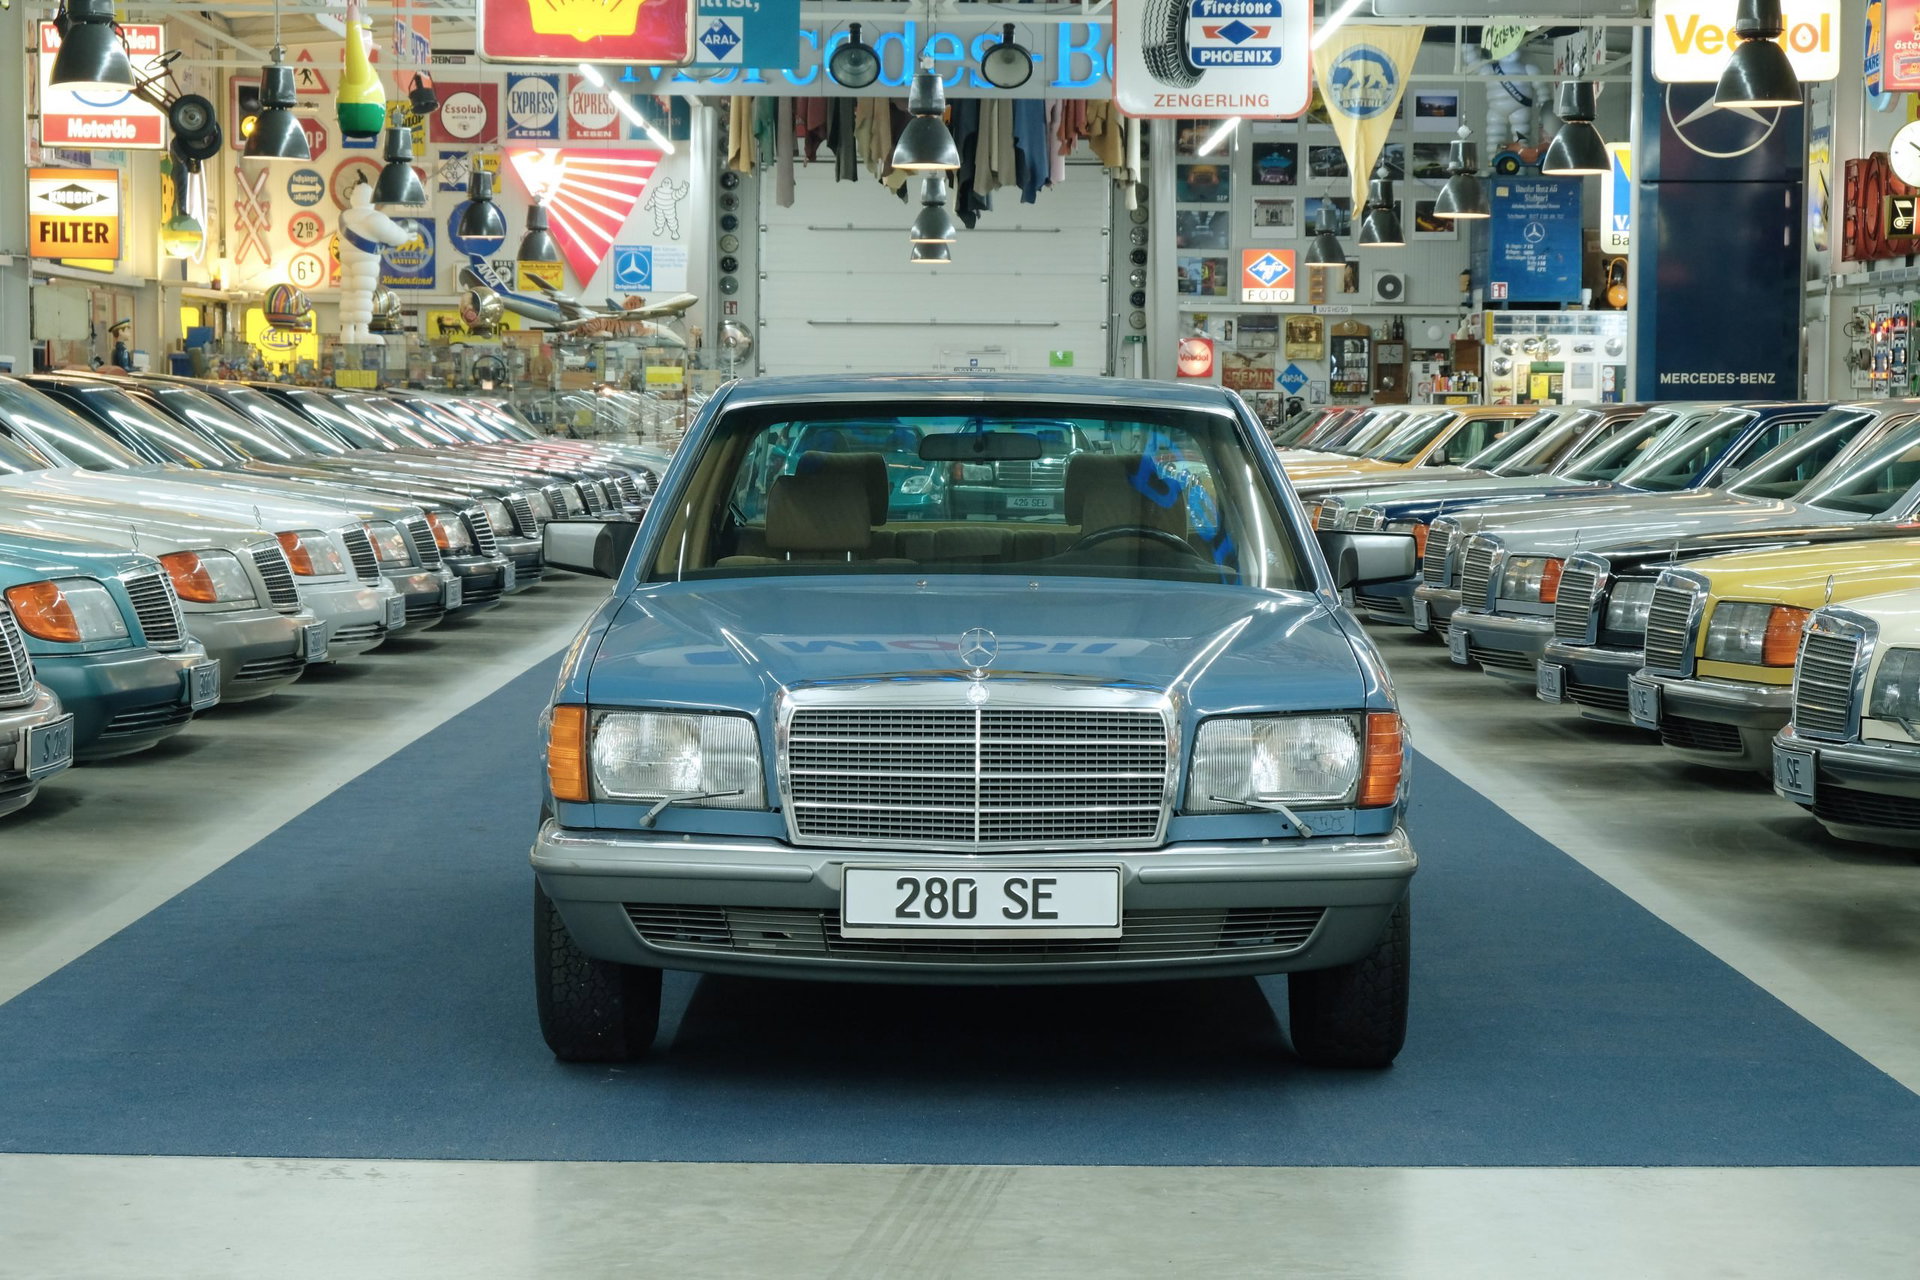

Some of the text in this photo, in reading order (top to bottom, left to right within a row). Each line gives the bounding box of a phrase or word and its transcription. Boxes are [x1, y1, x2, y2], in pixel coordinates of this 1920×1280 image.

[1201, 1, 1273, 16] Firestone
[704, 35, 737, 45] ARAL
[1201, 51, 1273, 63] PHOENIX
[512, 92, 555, 114] EXPRESS
[1154, 94, 1270, 107] ZENGERLING
[445, 104, 483, 114] Essolub
[67, 118, 137, 139] Motoröle
[40, 221, 109, 244] FILTER
[297, 222, 304, 238] 2
[298, 262, 305, 280] 6
[1248, 290, 1289, 300] FOTO
[1660, 372, 1776, 384] MERCEDES-BENZ
[1786, 756, 1802, 789] SE
[895, 877, 1058, 919] 280 SE
